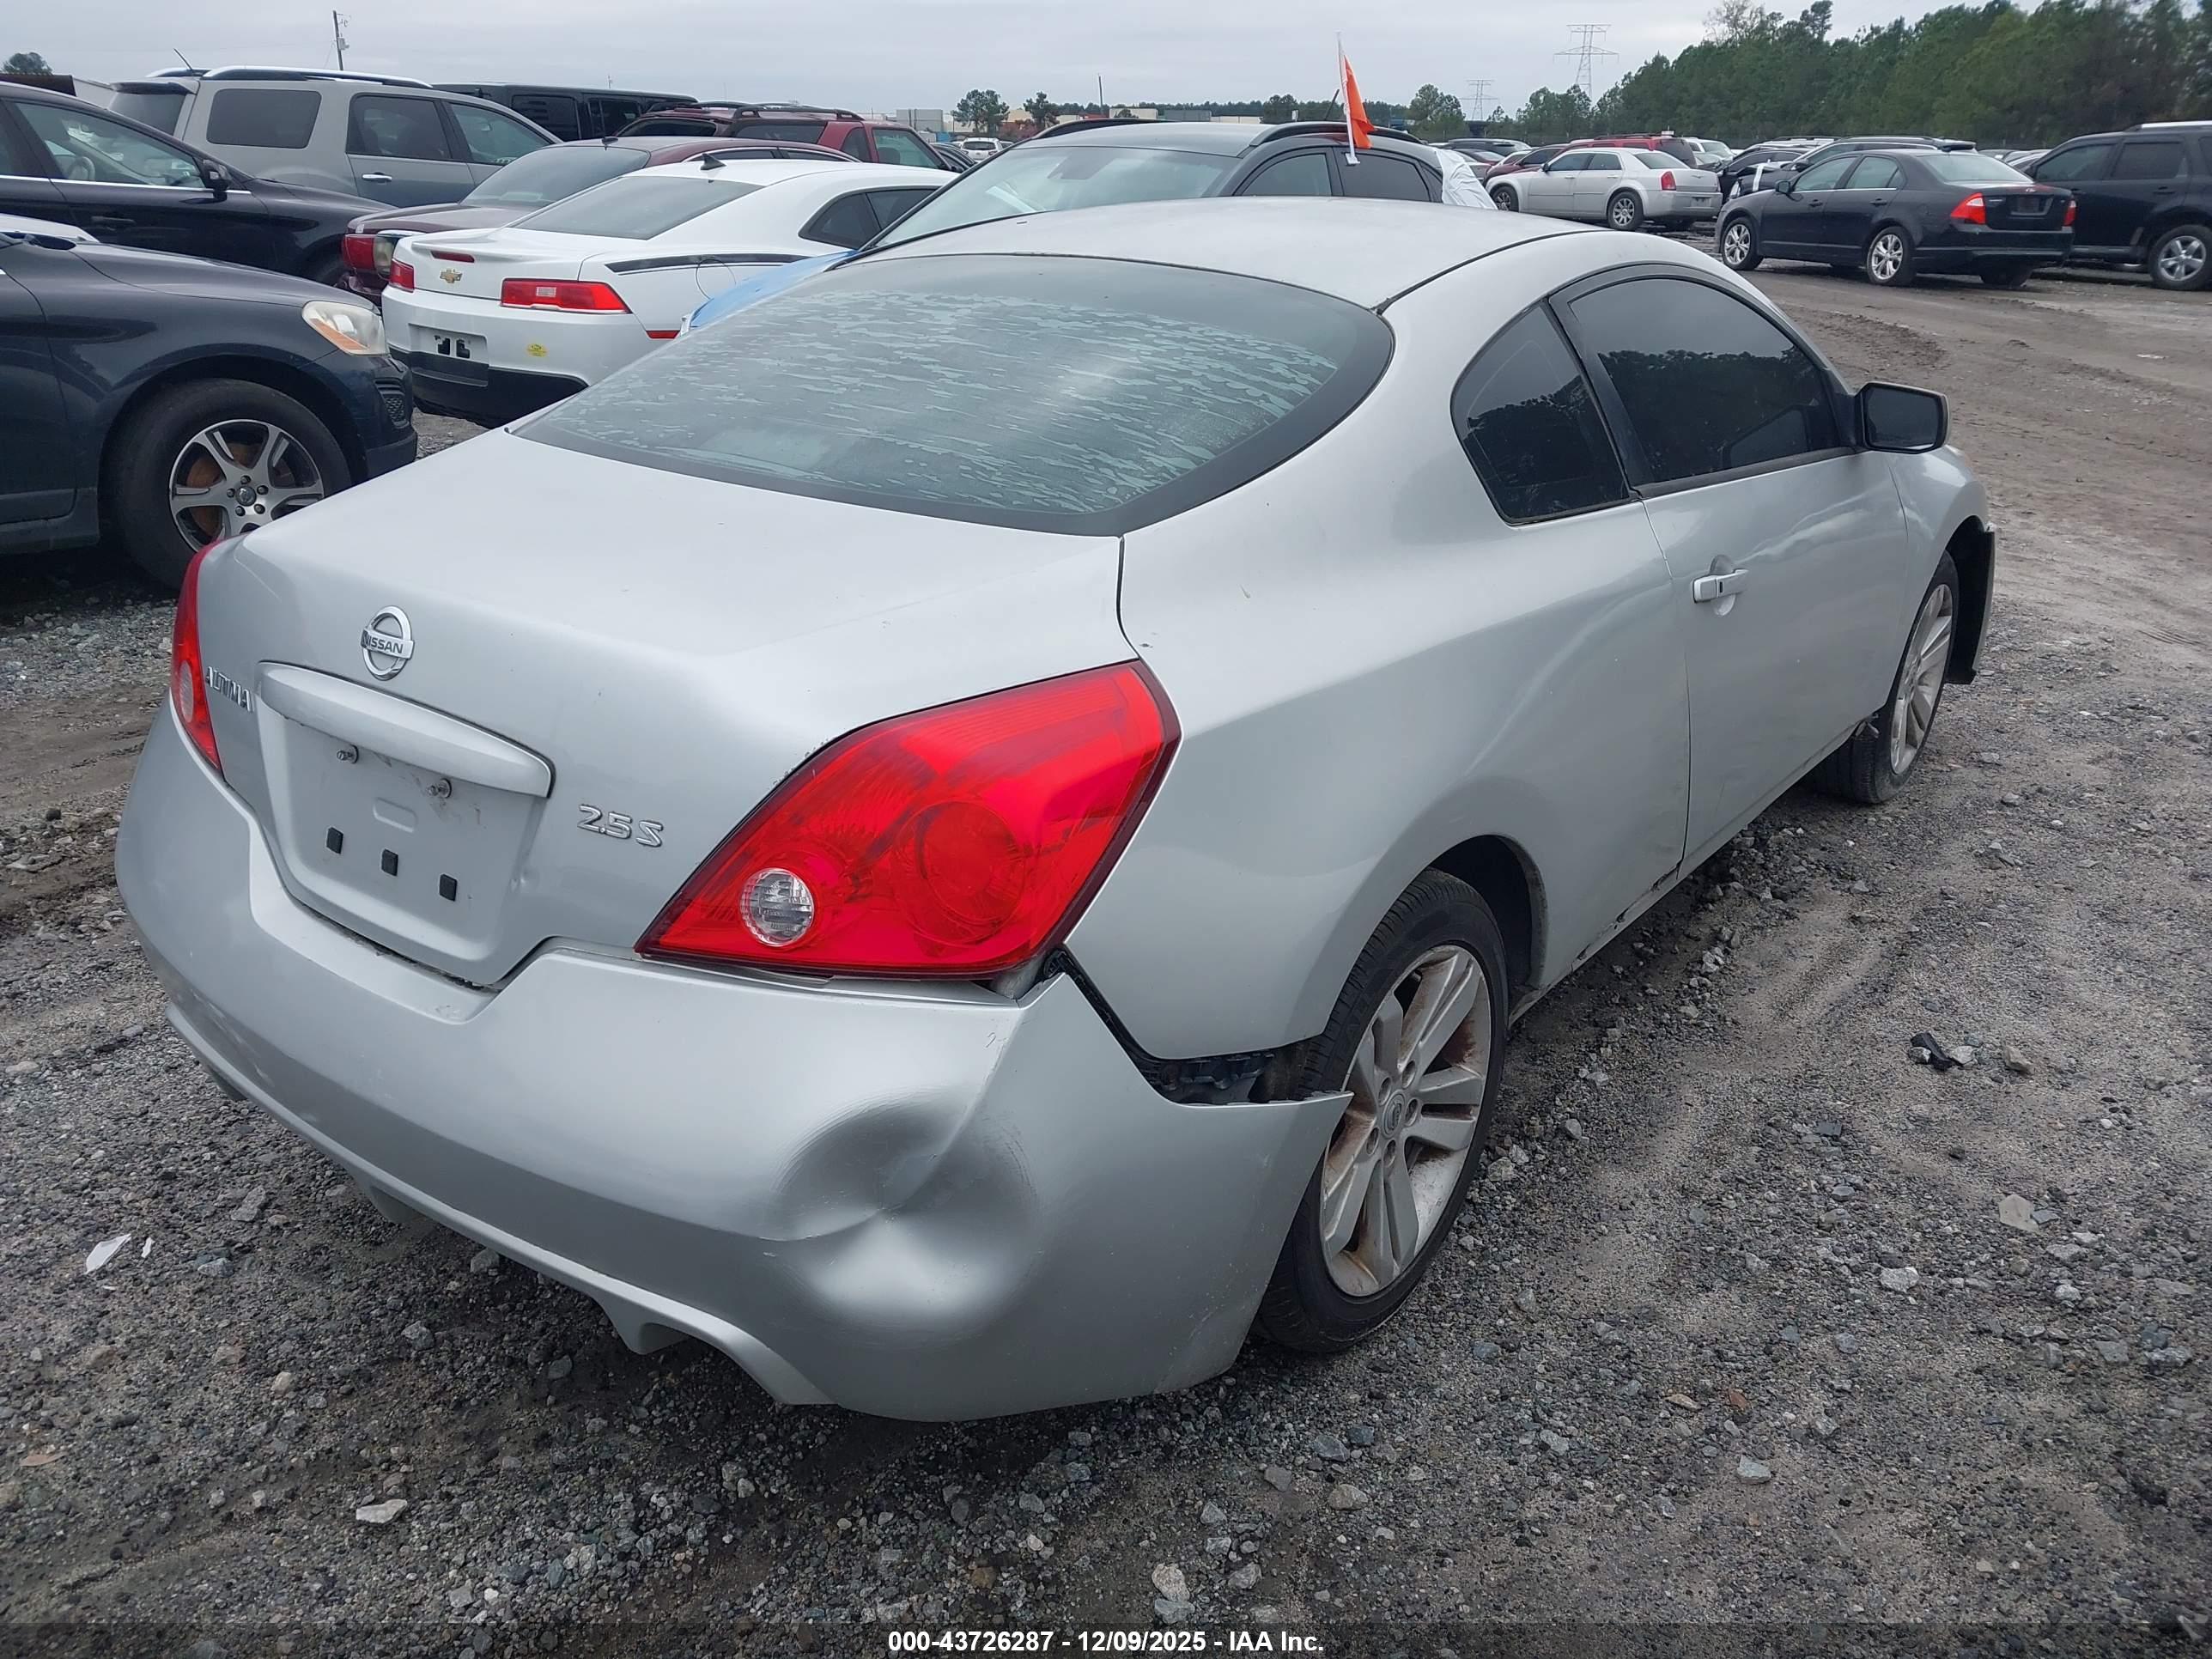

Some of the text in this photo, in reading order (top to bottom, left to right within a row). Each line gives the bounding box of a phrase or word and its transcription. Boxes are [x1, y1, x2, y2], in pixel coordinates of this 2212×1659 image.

[360, 632, 404, 654] NISSAN
[205, 665, 254, 714] ALTIMA
[577, 803, 665, 848] 2.5 S
